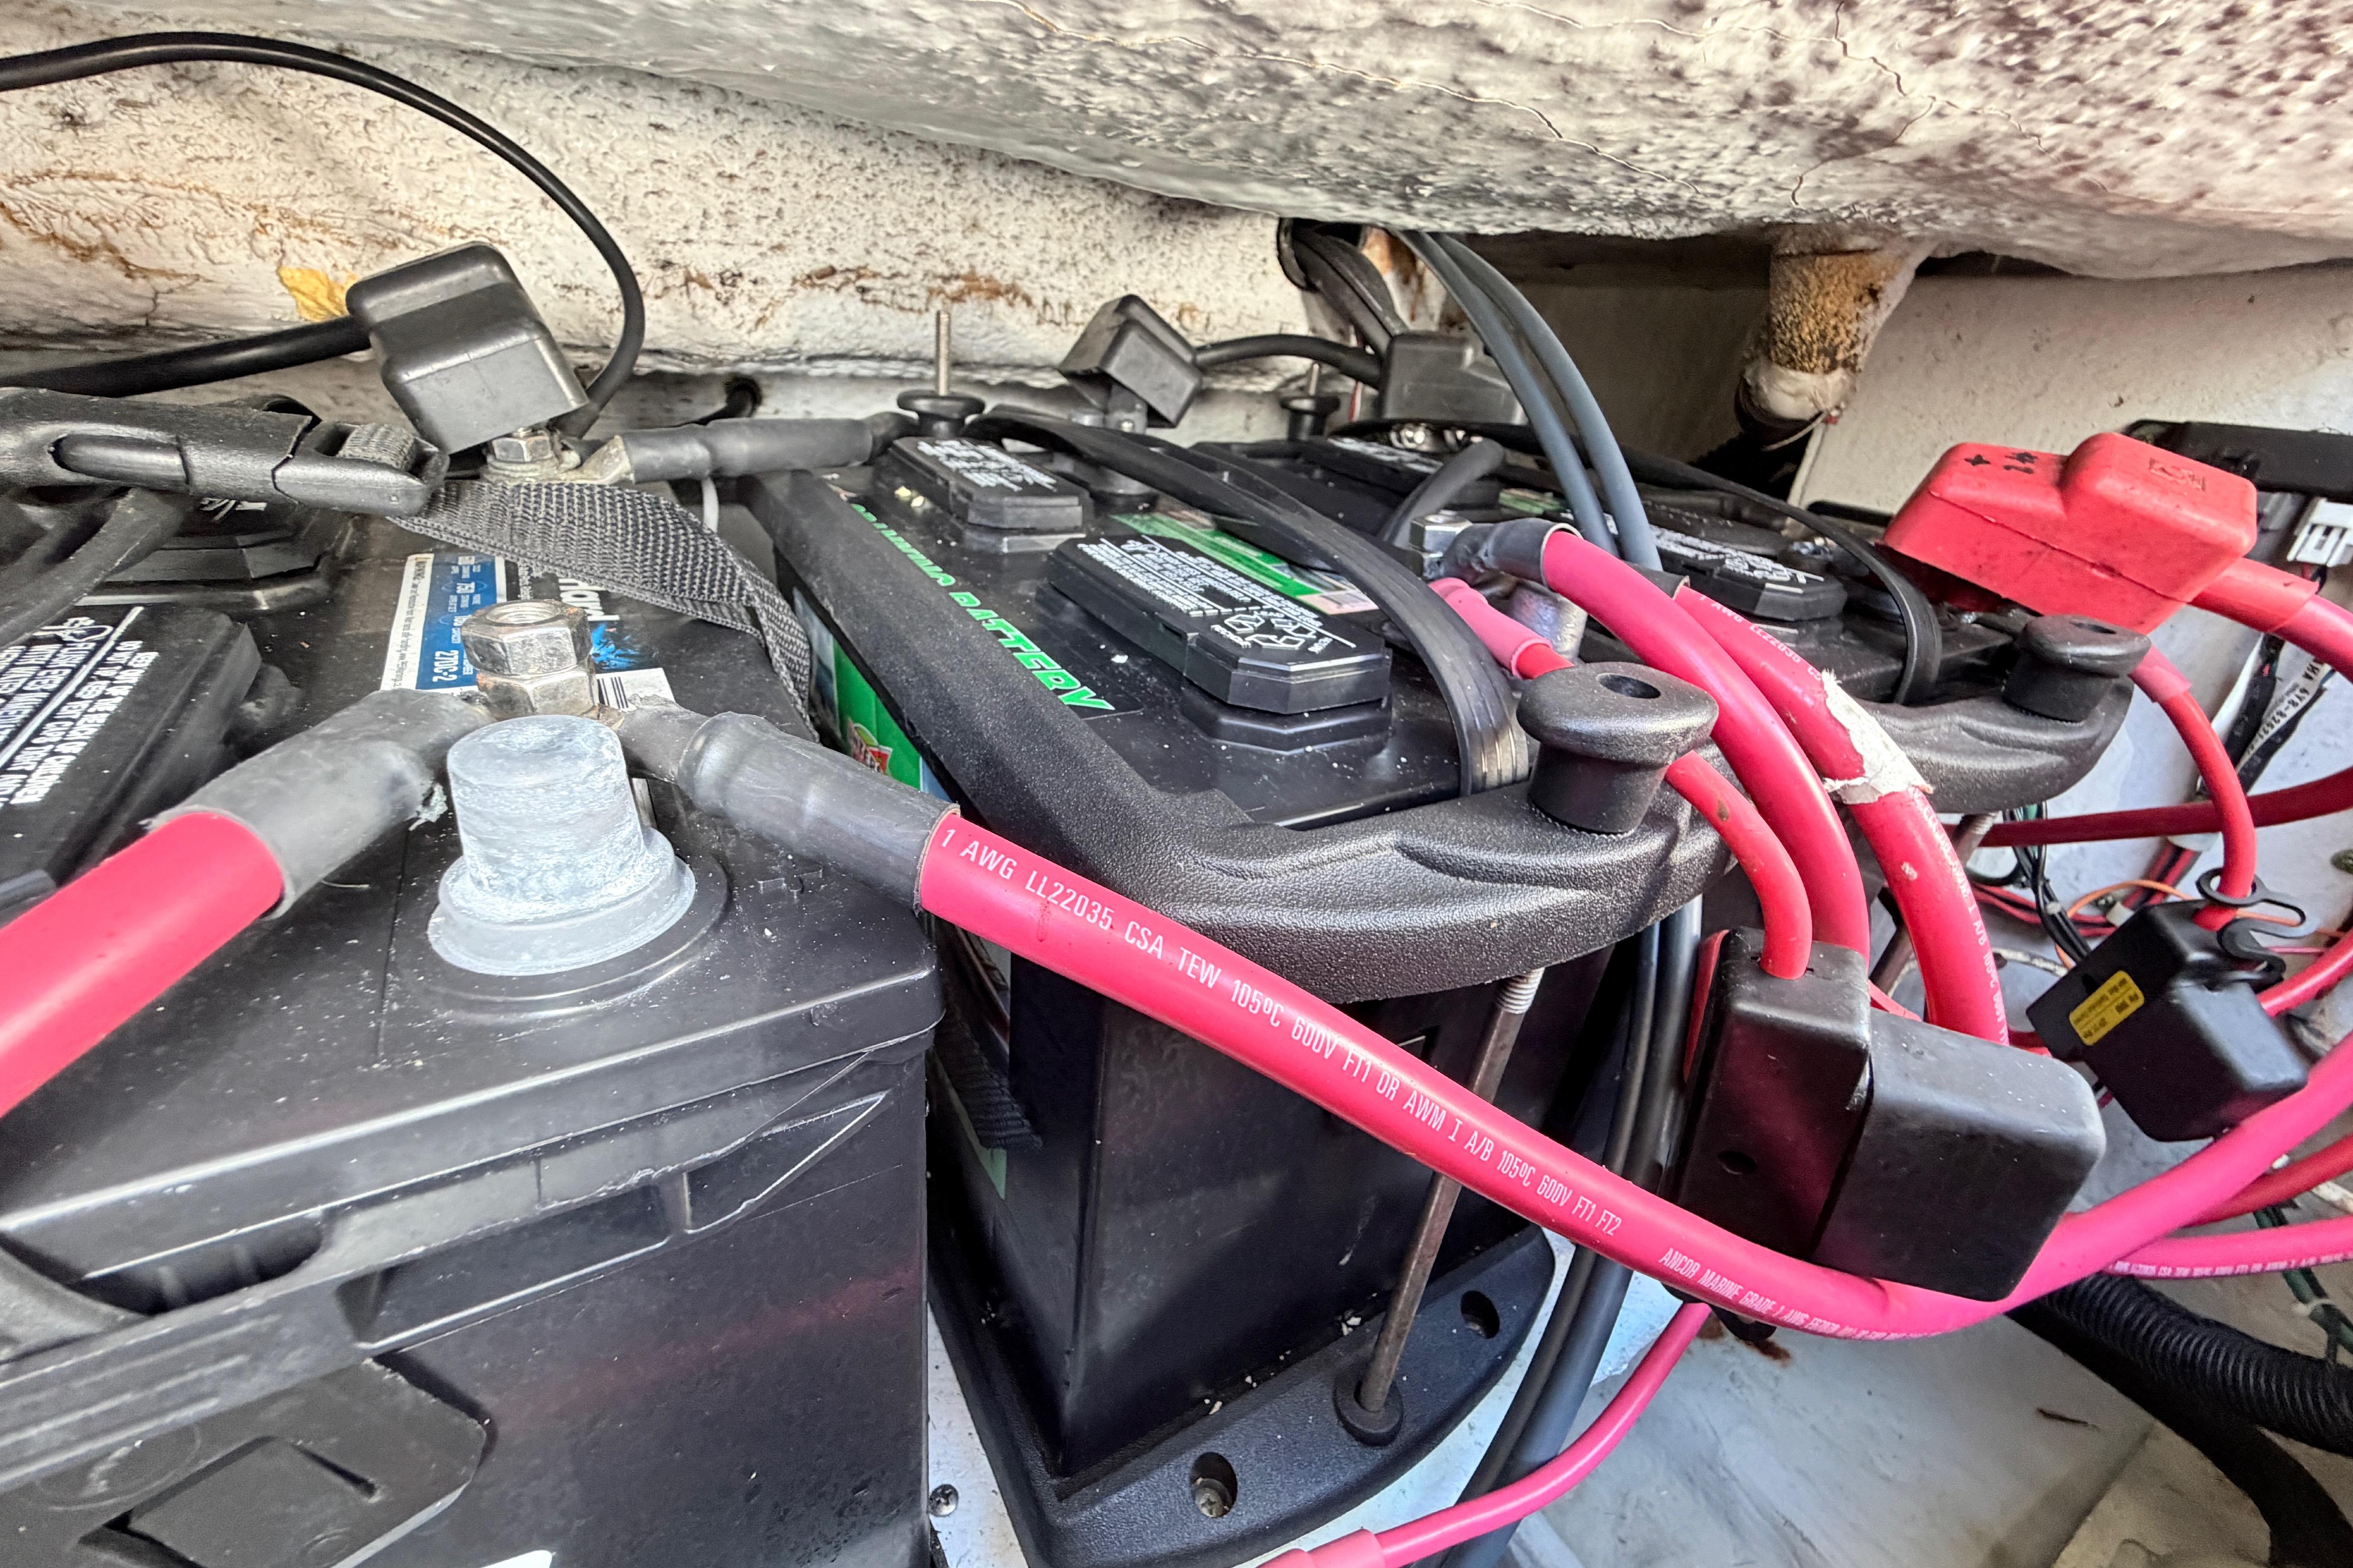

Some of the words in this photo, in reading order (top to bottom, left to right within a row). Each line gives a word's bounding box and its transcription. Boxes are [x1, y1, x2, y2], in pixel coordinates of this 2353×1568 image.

[1711, 601, 1743, 623] AWG
[1748, 623, 1801, 663] LL22035
[1807, 666, 1823, 681] CS
[14, 644, 64, 665] WITH
[45, 642, 96, 668] FLUSH
[22, 669, 73, 691] EYES
[111, 669, 145, 684] OUT
[53, 700, 94, 719] VENT
[87, 696, 124, 712] THE
[30, 721, 74, 743] CAPS
[63, 713, 111, 740] REACH
[6, 745, 55, 771] TIGHT
[1972, 922, 1987, 946] A/B
[941, 828, 956, 848] 1
[959, 840, 1018, 881] AWG
[1024, 870, 1115, 931] LL22035
[1124, 920, 1163, 960] CSA
[1177, 946, 1222, 989] TEW
[1291, 1017, 1340, 1060] 600V
[1341, 1050, 1372, 1083] FT1
[1375, 1071, 1400, 1102] OR
[1402, 1089, 1447, 1132] AWM
[1463, 1130, 1495, 1162] A/B
[1536, 1174, 1573, 1207] 600V
[1571, 1195, 1597, 1223] FT1
[1595, 1209, 1623, 1237] FT2
[1657, 1247, 1701, 1279] ANCOR
[1697, 1268, 1743, 1301] MARINE
[1738, 1290, 1776, 1315] GRADE
[1781, 1307, 1810, 1328] AWG
